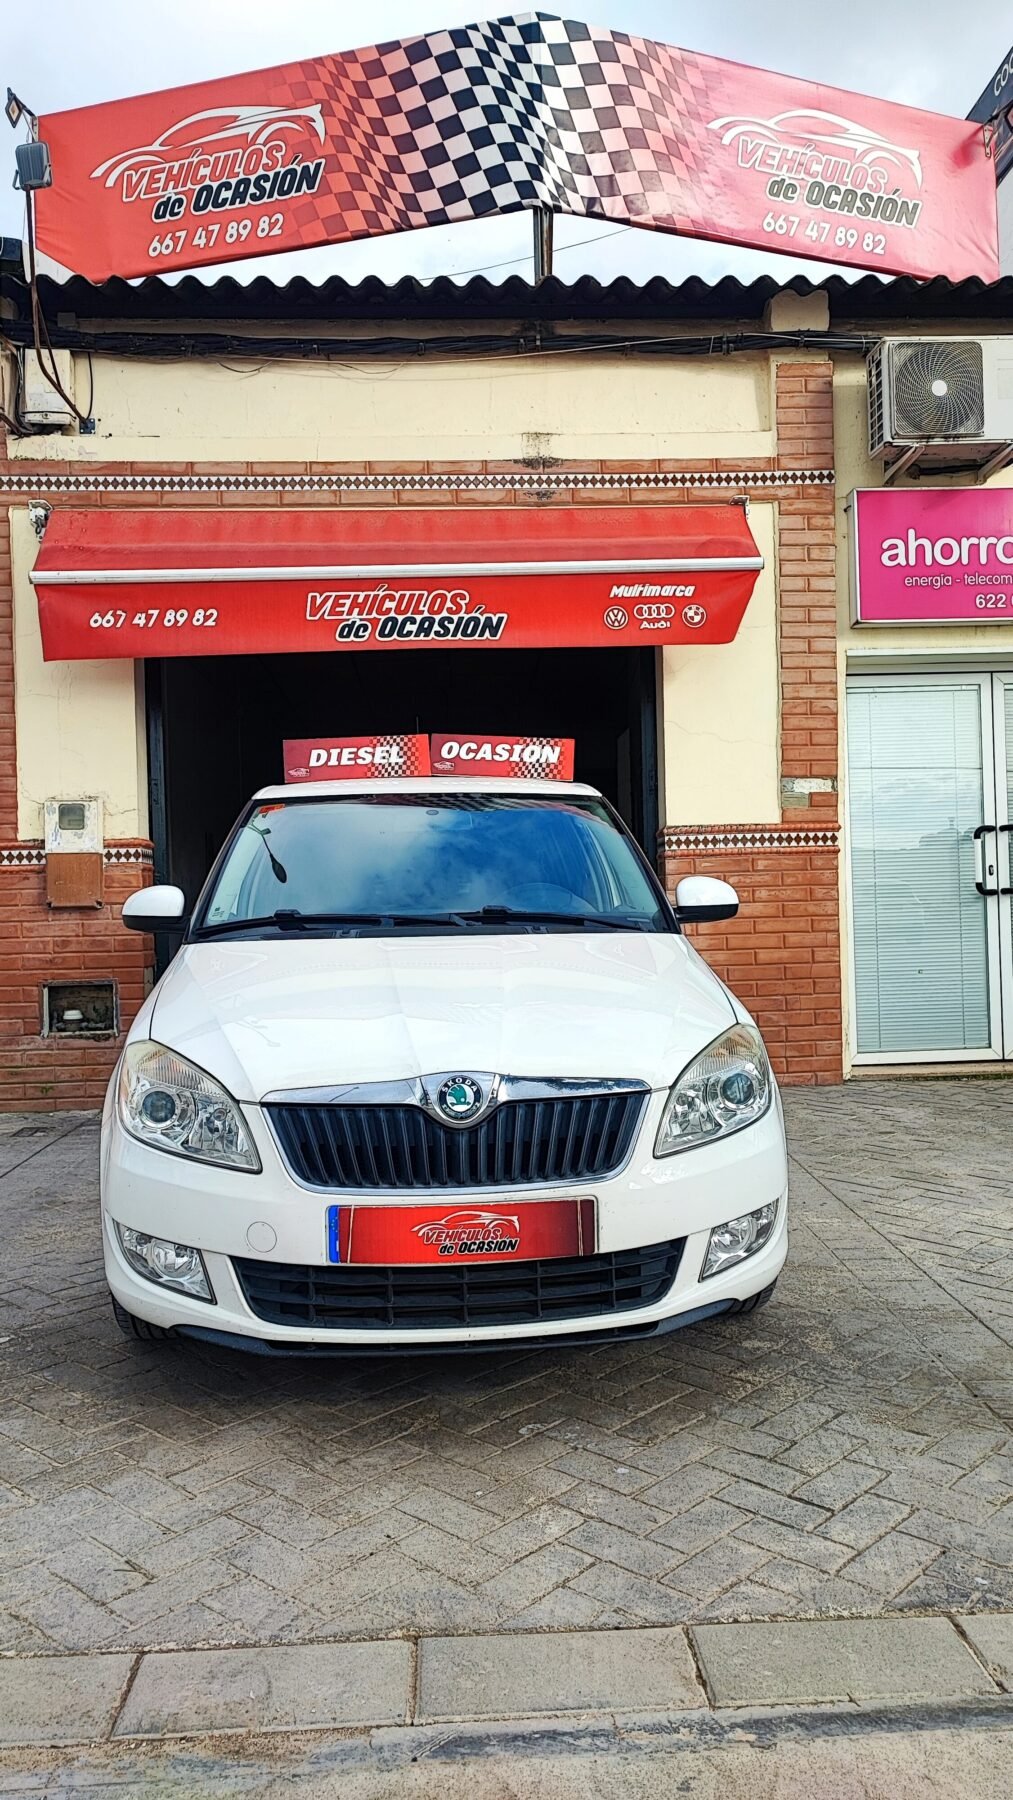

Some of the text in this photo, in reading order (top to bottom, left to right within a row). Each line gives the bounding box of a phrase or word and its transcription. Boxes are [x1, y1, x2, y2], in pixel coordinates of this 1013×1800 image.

[122, 140, 286, 202] VEHÍCULOS
[737, 136, 888, 195] VEHÍCULOS
[152, 154, 325, 223] de OCASIÓN
[766, 176, 923, 229] de OCASIÓN
[148, 213, 283, 257] 667 47 89 82
[762, 212, 886, 255] 667 47 89 82
[609, 583, 696, 598] Multimarca
[904, 573, 952, 590] energía
[306, 584, 470, 620] VEHÍCULOS
[975, 593, 1007, 609] 622
[89, 608, 218, 628] 667 47 89 82
[336, 605, 508, 642] de OCASIÓN
[639, 620, 671, 629] Audi
[309, 745, 405, 767] DIESEL
[424, 1225, 502, 1244] VEHÍCULOS
[438, 1236, 520, 1255] de OCASIÓN
